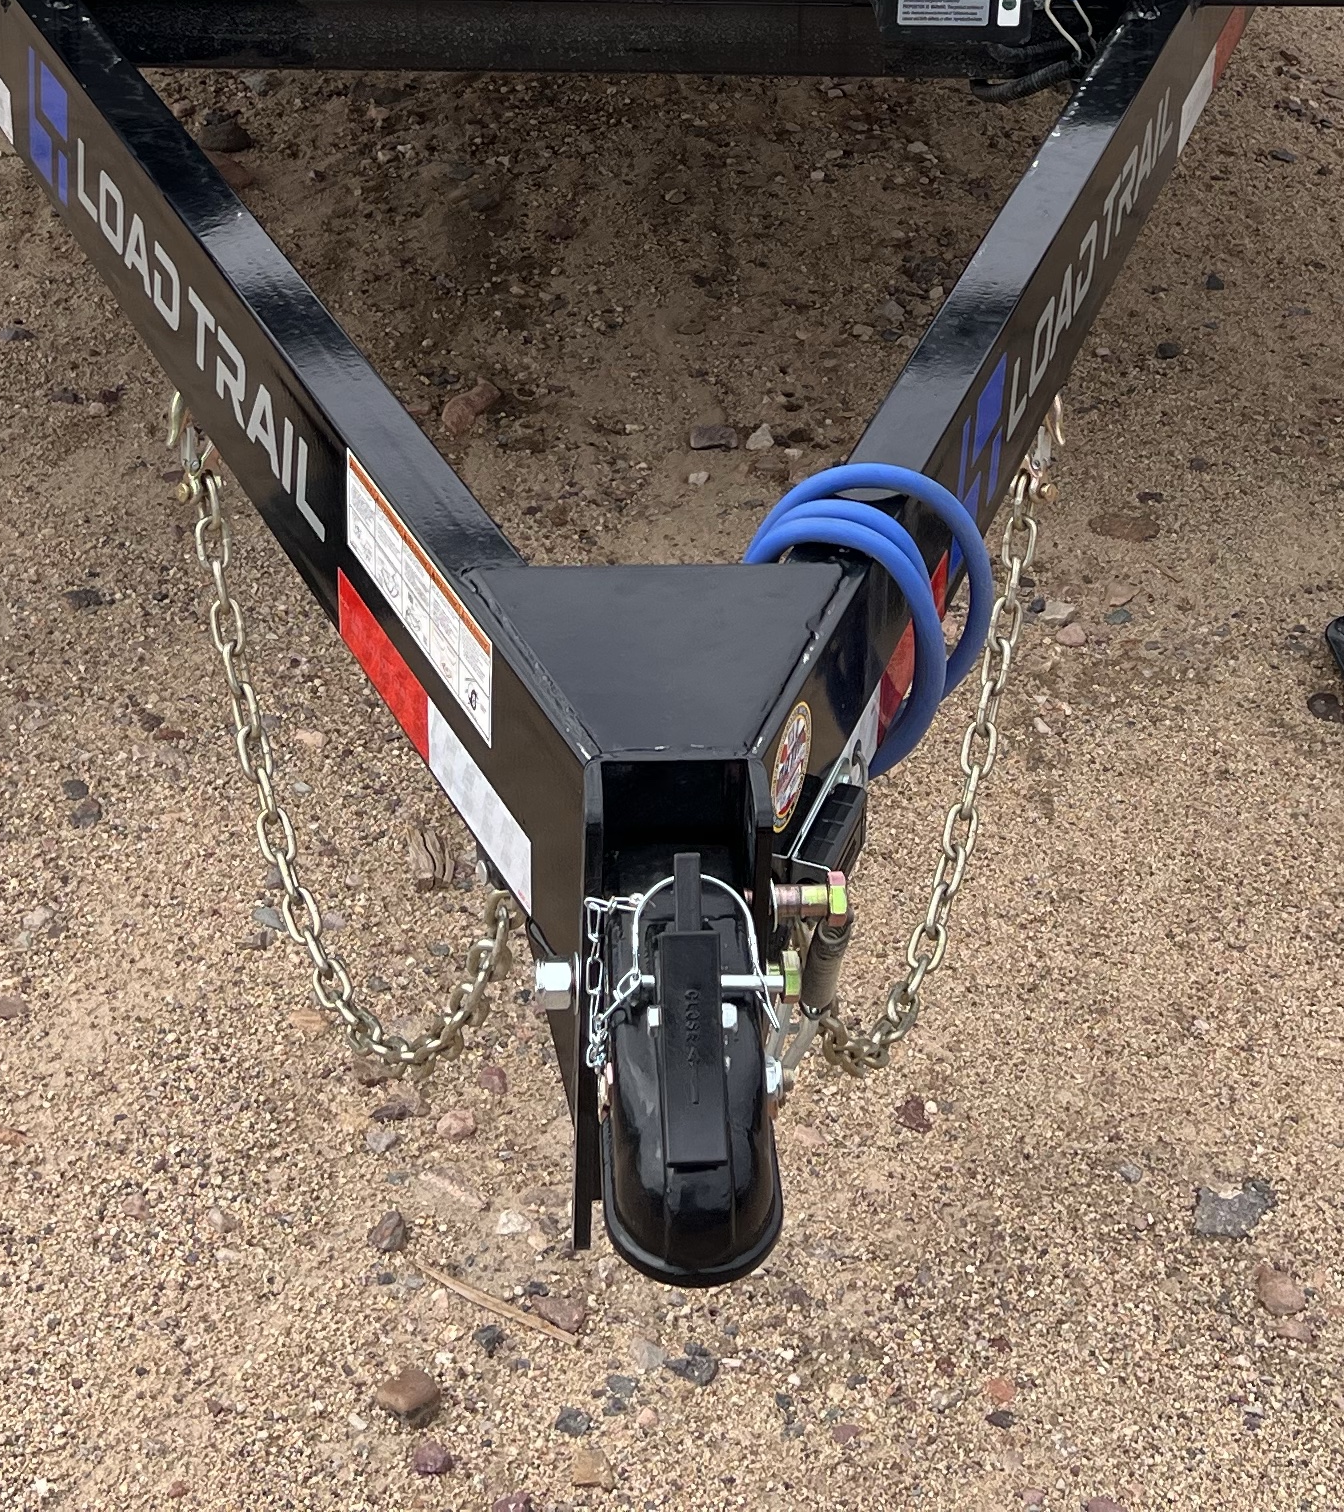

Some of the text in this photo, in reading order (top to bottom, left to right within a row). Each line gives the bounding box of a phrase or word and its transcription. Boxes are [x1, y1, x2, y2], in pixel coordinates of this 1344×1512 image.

[76, 137, 325, 544] LOAD TRAIL
[1006, 86, 1173, 443] LOAD TRAIL
